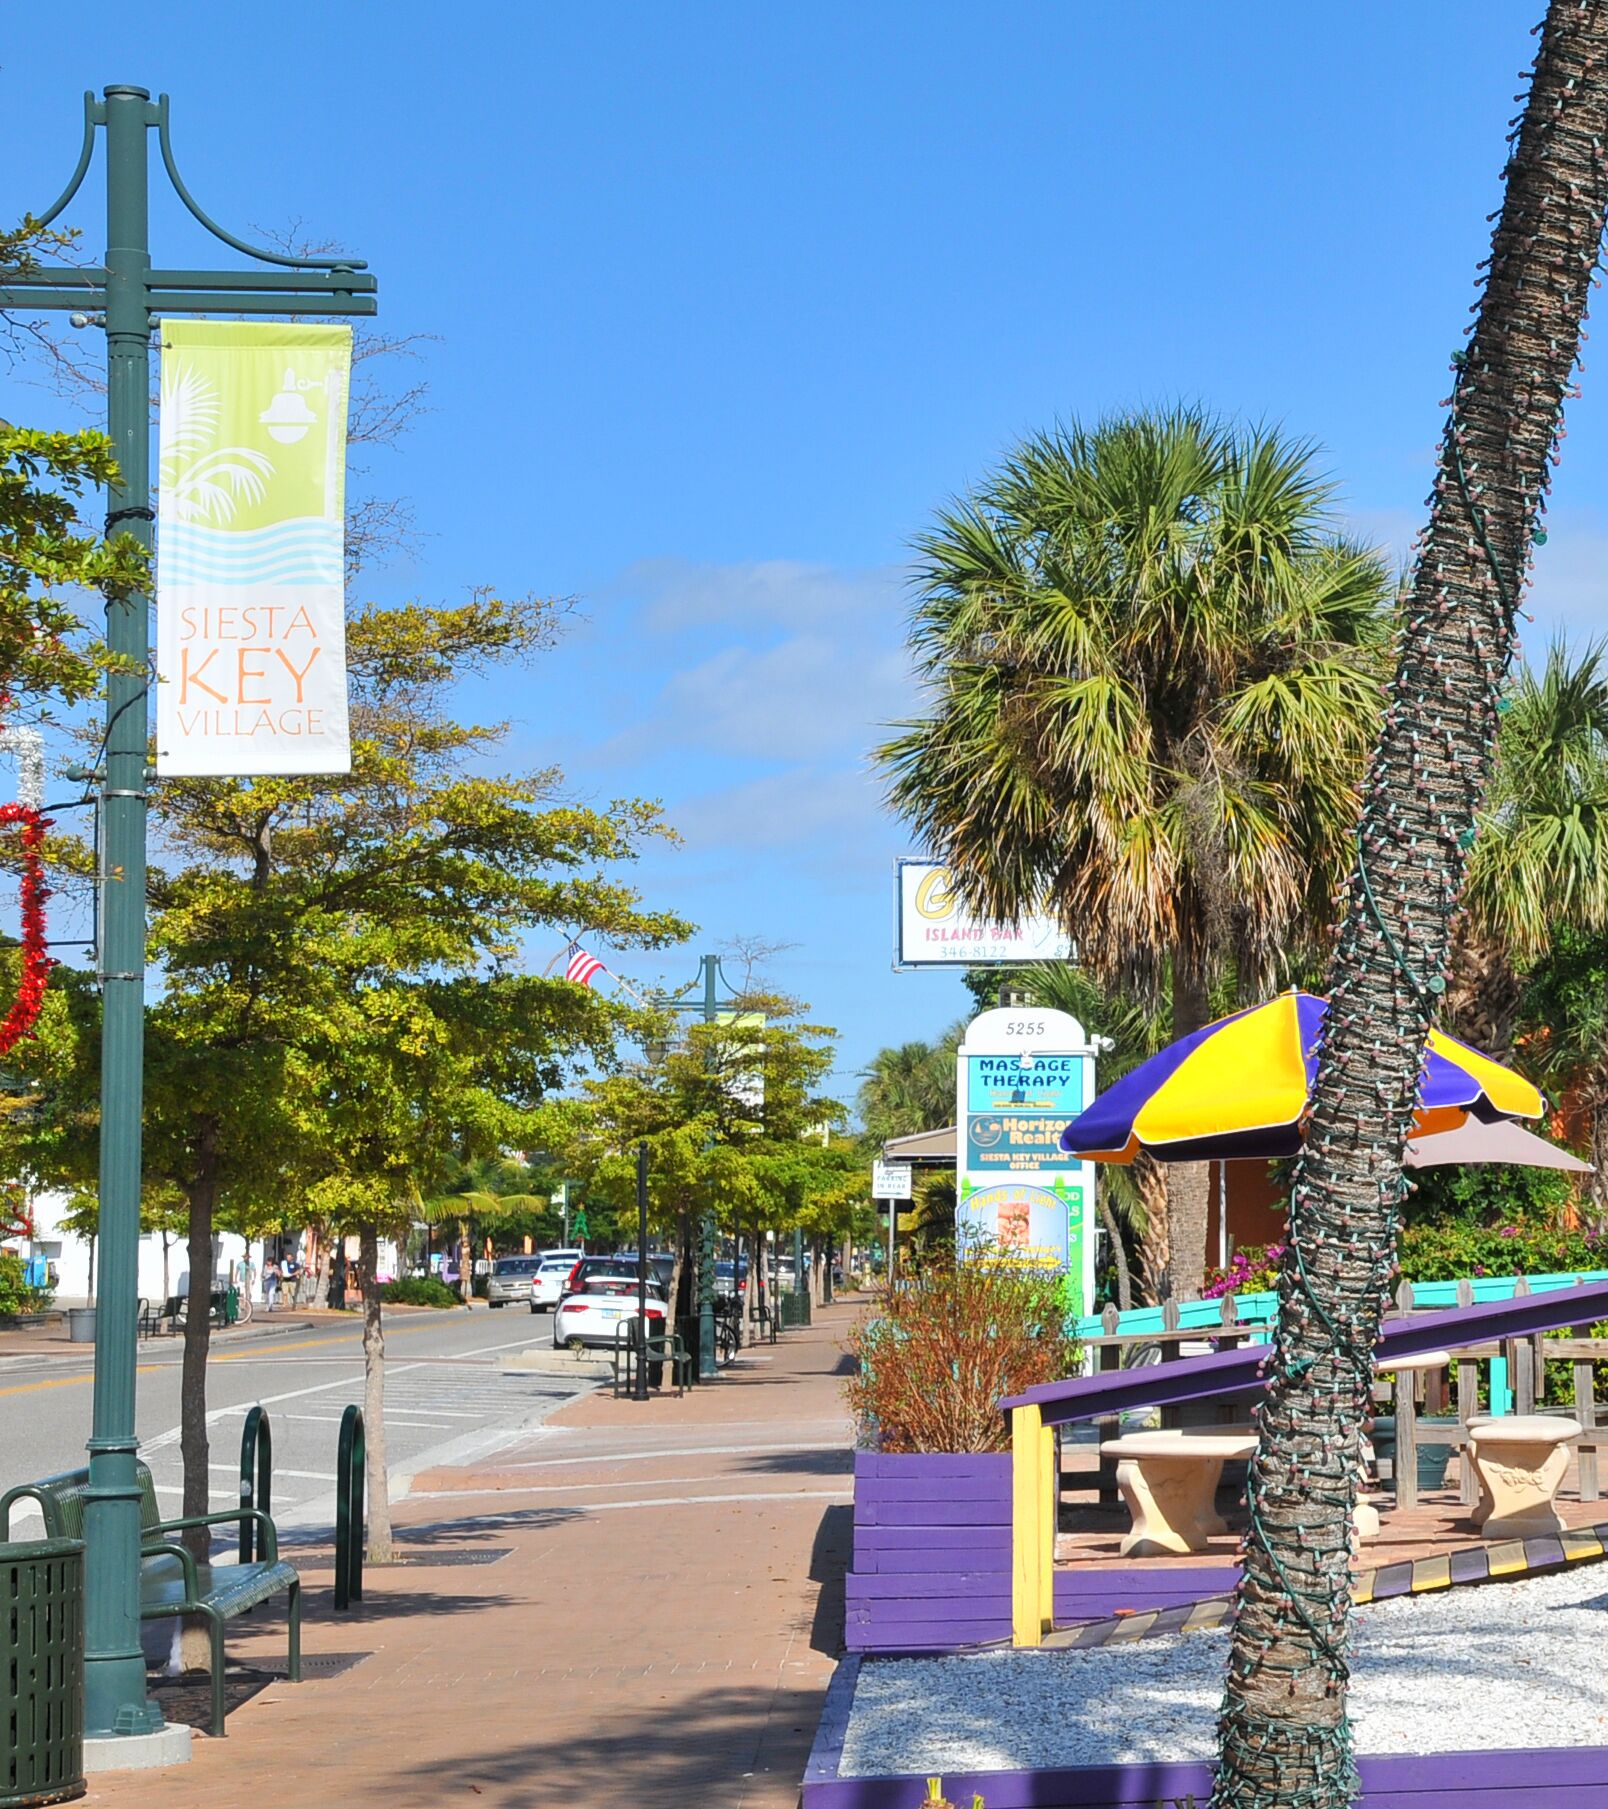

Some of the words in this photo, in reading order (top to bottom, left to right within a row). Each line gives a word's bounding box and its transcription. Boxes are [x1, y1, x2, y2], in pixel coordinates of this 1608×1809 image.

[180, 605, 317, 640] SIESTA
[179, 647, 321, 704] KEY
[177, 709, 325, 736] VILLAGE
[925, 928, 984, 942] ISLAND
[991, 928, 1024, 942] BAR
[939, 945, 1008, 959] 346-8122
[1006, 1022, 1045, 1036] 5255
[980, 1060, 1071, 1071] MASAGE
[980, 1075, 1071, 1087] THERAPY
[1010, 1131, 1059, 1145] Realt
[981, 1153, 1010, 1161] SIESTA
[1012, 1153, 1031, 1161] KEY
[1032, 1153, 1069, 1161] VILLAGE
[1009, 1162, 1039, 1170] OFFICE
[970, 1189, 1008, 1211] Hands
